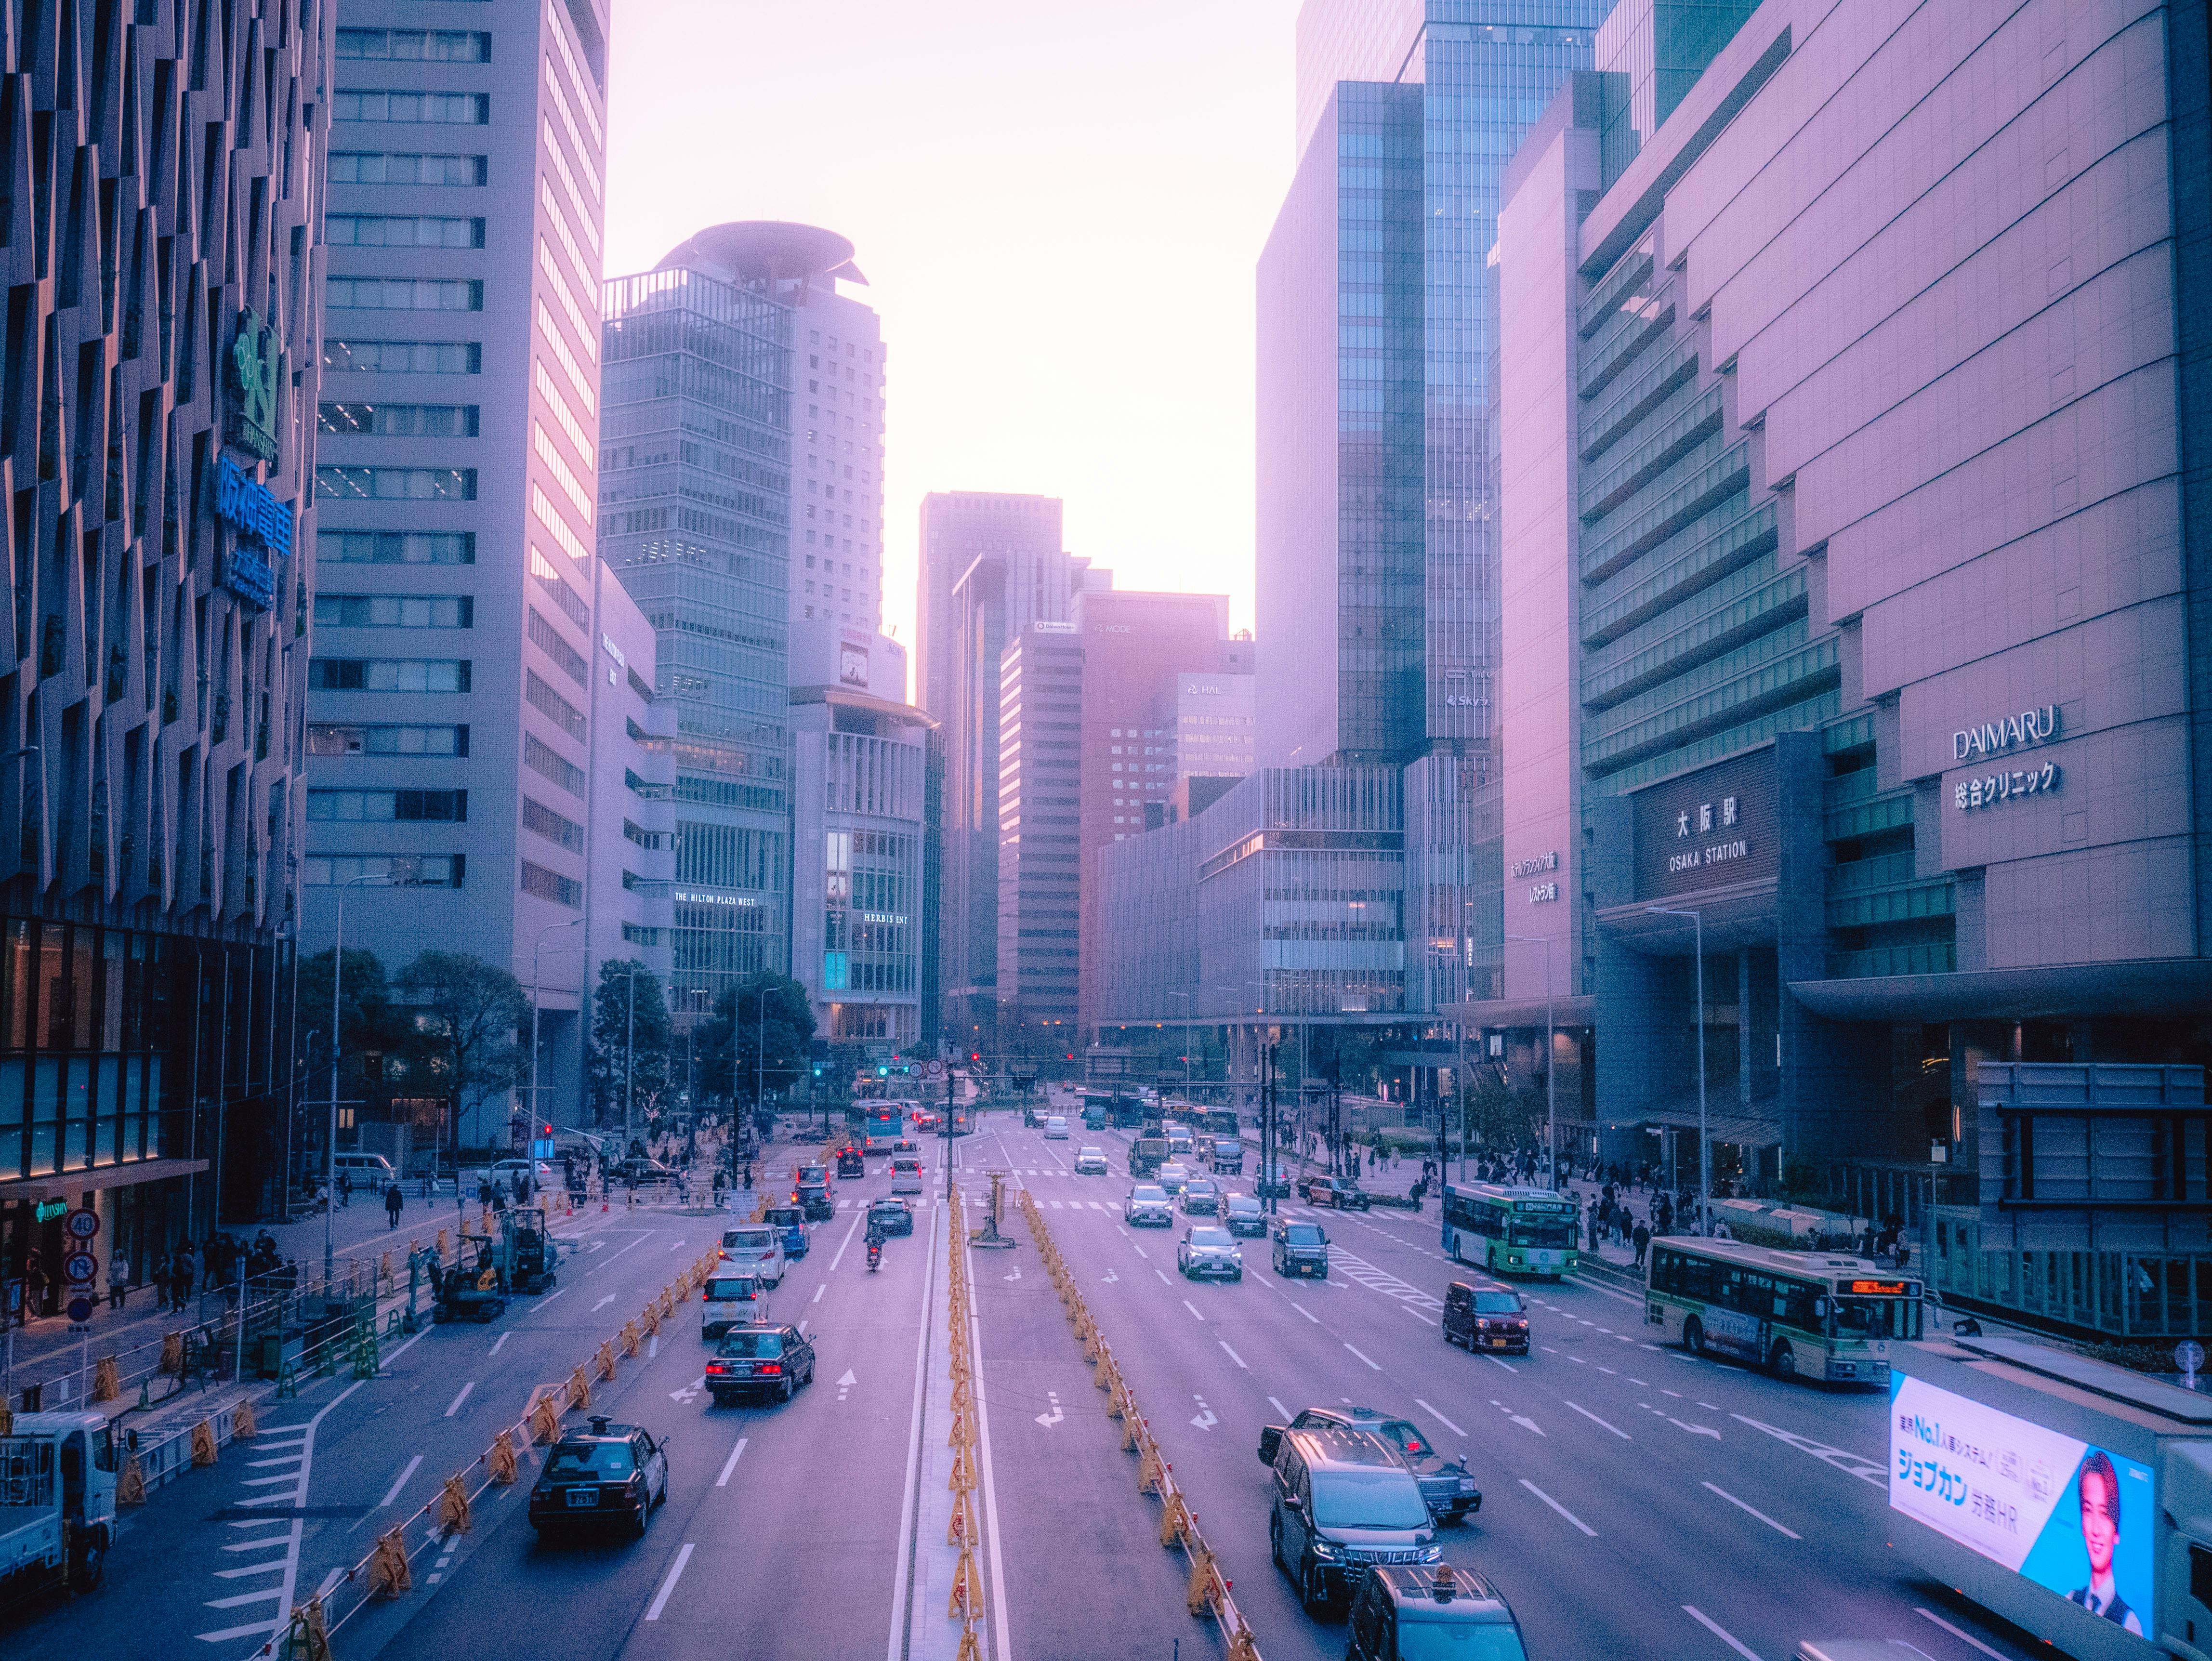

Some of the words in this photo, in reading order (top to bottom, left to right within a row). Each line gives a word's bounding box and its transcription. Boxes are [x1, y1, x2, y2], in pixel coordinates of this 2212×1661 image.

[219, 455, 292, 556] 阪神電車
[1106, 625, 1131, 633] MODE
[1202, 686, 1221, 695] HAL
[1953, 705, 2053, 759] DAIMARU
[1955, 762, 2053, 810] 総合クリニック
[1678, 796, 1735, 838] 大阪駅
[1670, 851, 1699, 872] OSAKA
[1706, 841, 1745, 864] STATION
[675, 893, 686, 901] THE
[691, 894, 714, 903] HILTON
[717, 896, 736, 905] PLAZA
[738, 897, 754, 907] WEST
[1529, 882, 1554, 904] レストラン街
[864, 913, 894, 923] HERBIS
[74, 1217, 92, 1231] 40
[1899, 1449, 1968, 1506] ジョブカン
[1972, 1488, 2019, 1535] 労務HR
